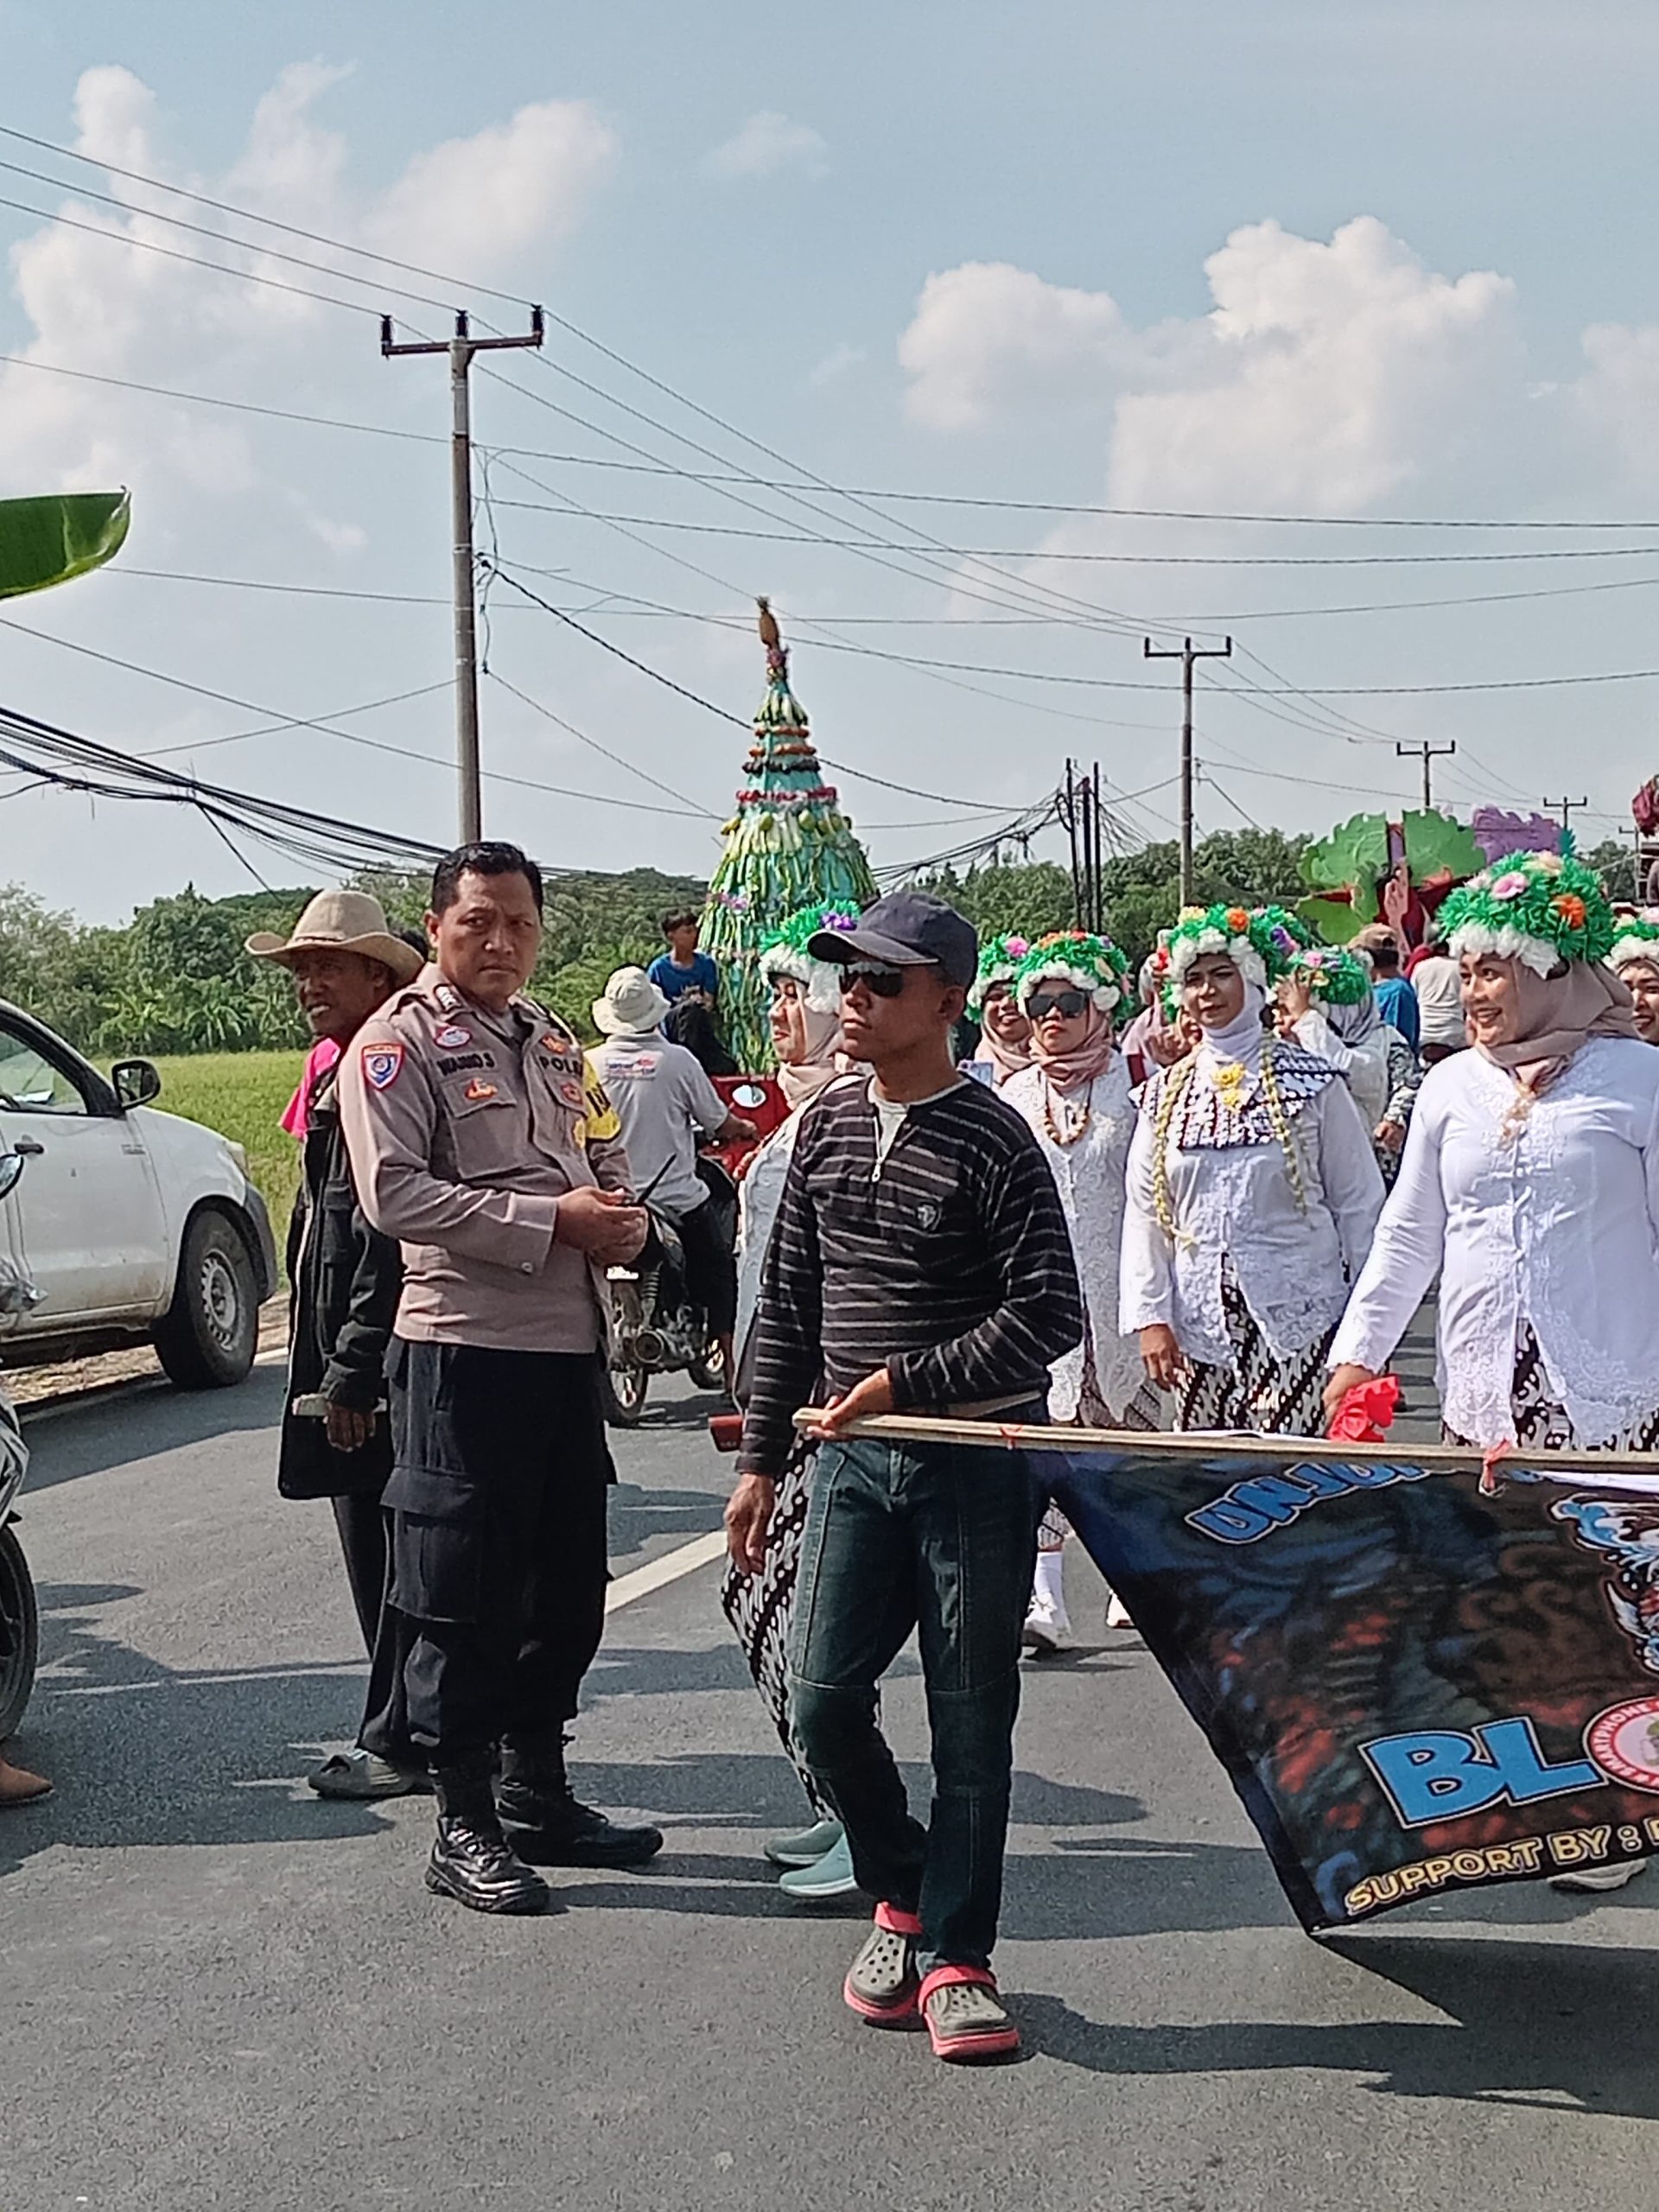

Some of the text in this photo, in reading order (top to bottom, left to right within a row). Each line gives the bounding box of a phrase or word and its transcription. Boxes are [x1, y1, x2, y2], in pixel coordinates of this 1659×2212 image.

[1591, 1700, 1649, 1777] SMARTPHONE
[1344, 1837, 1543, 1915] SUPPORT
[1547, 1825, 1611, 1866] BY
